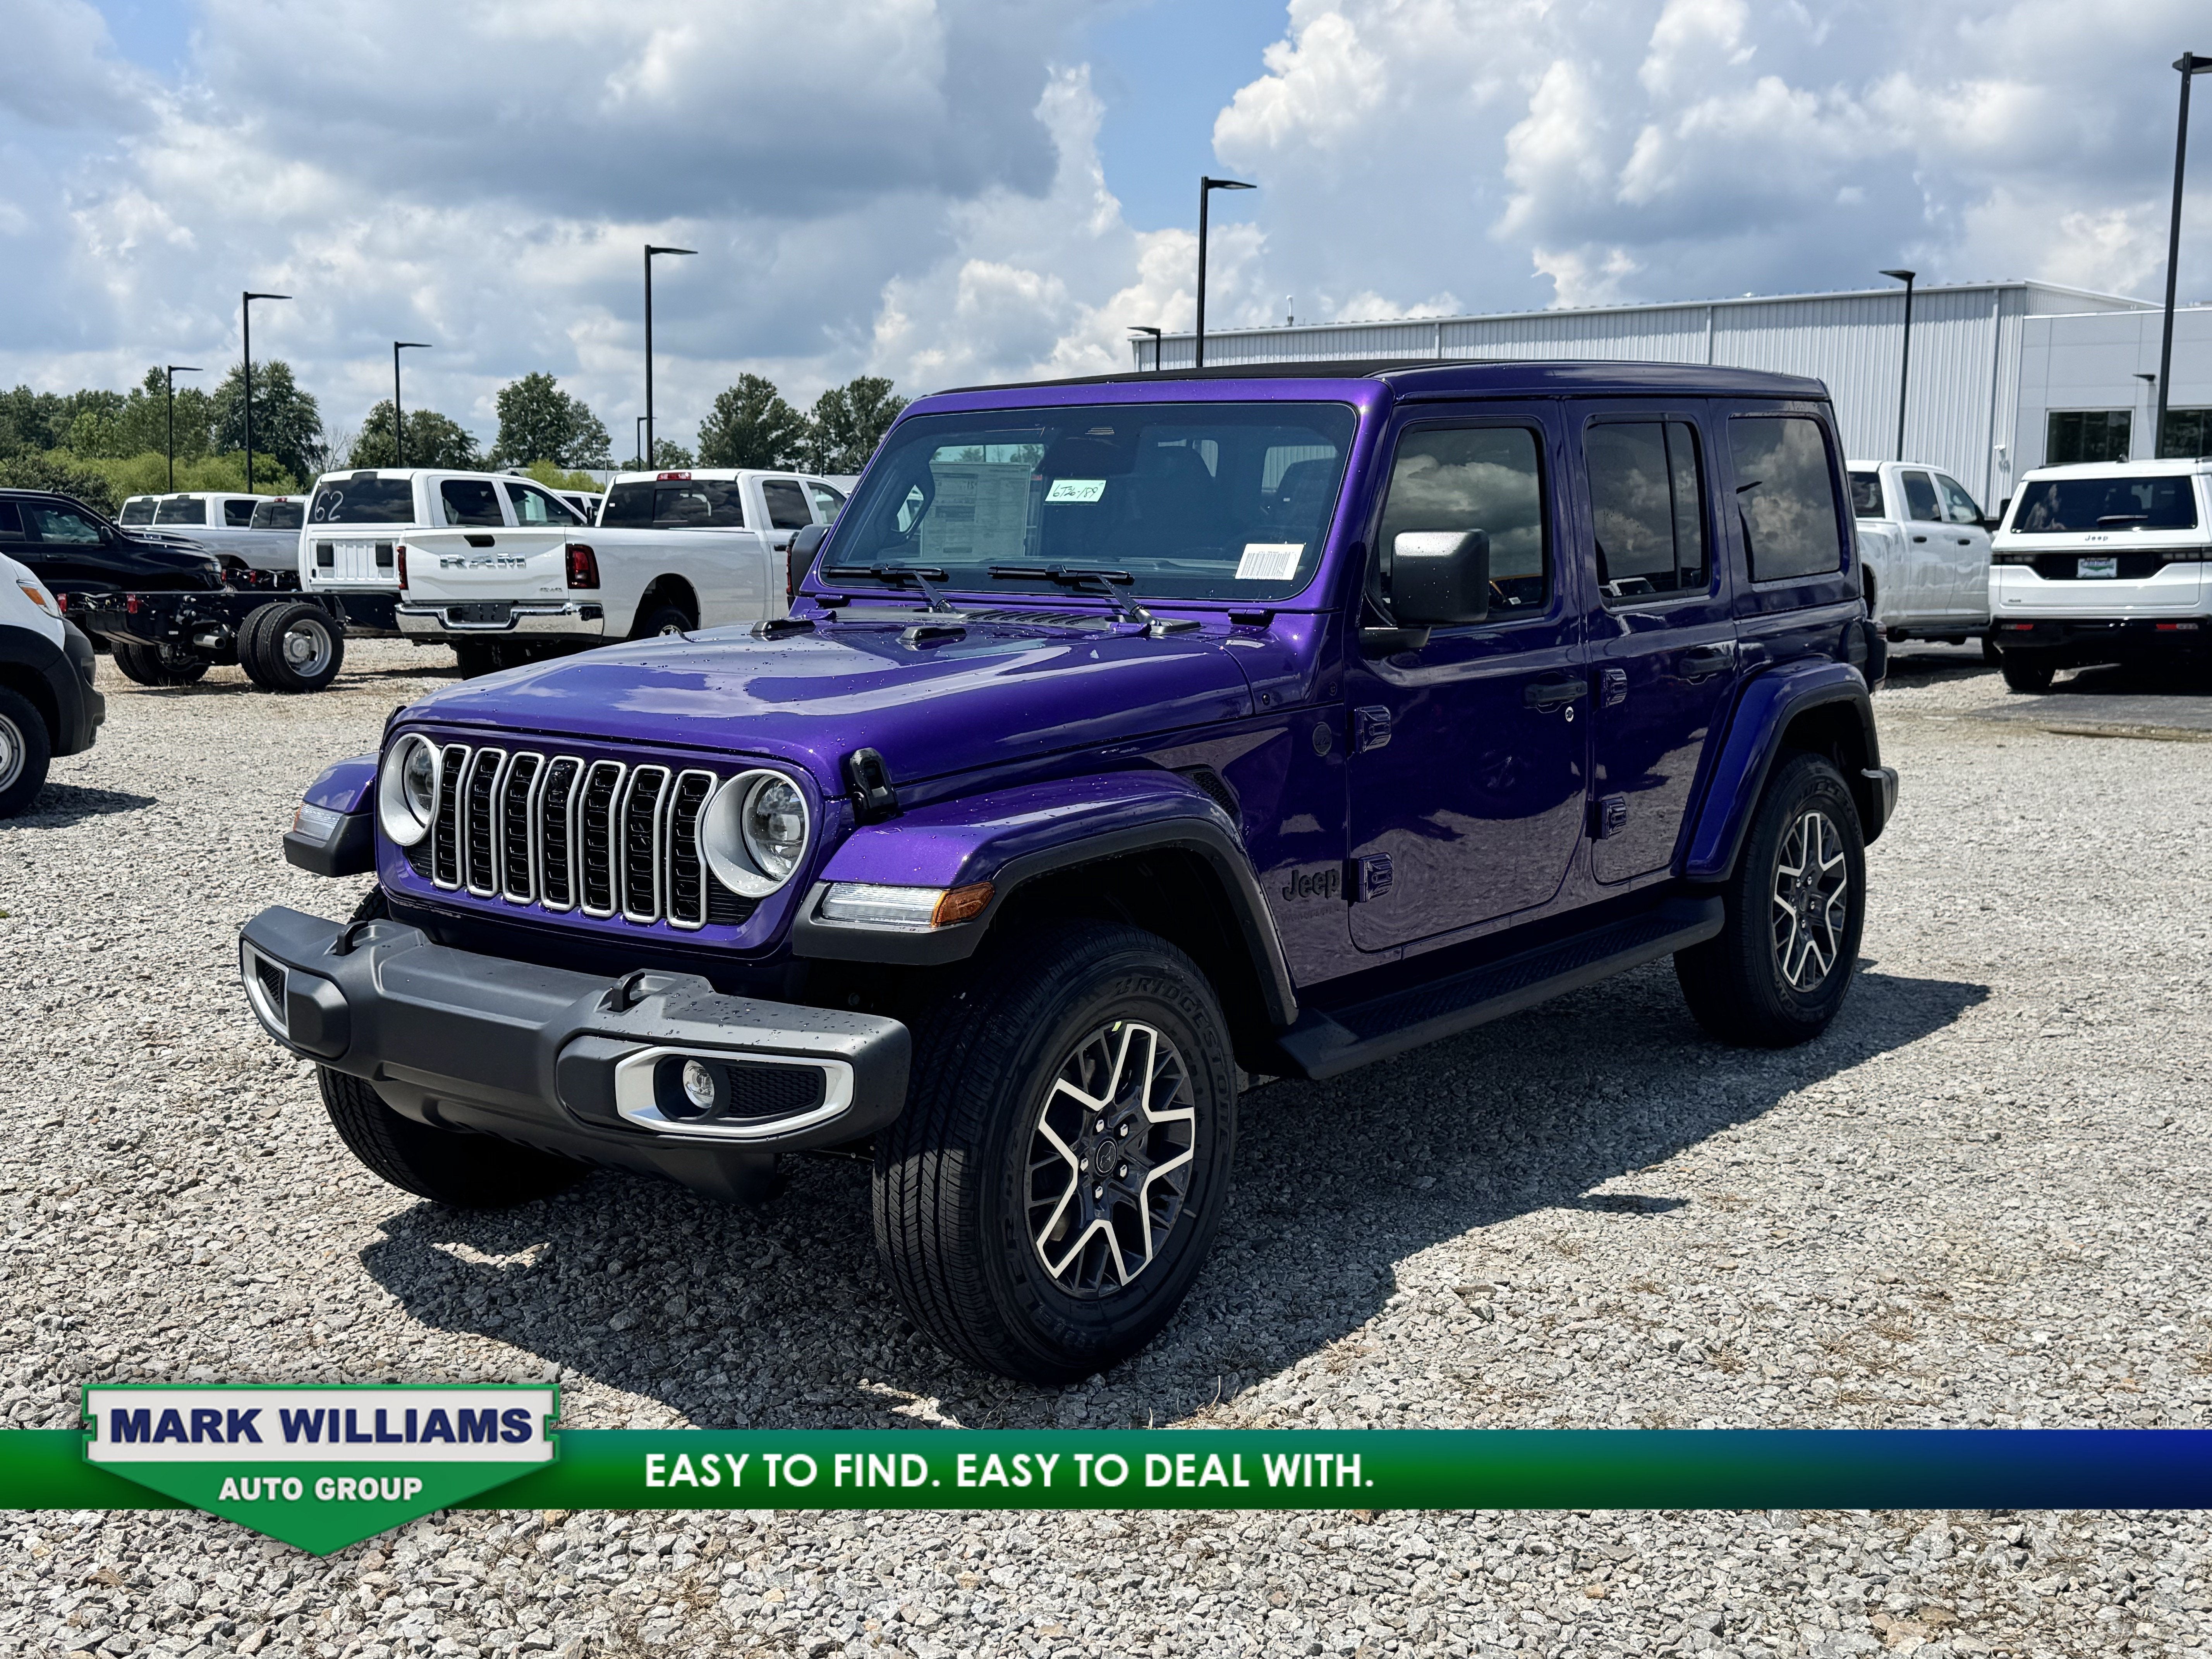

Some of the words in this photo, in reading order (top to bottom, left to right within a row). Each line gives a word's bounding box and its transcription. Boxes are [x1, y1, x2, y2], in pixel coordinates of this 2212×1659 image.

[314, 489, 343, 522] 62
[440, 552, 527, 570] RAM
[1282, 868, 1340, 902] Jeep
[1112, 977, 1230, 1153] BRIDGESTONE
